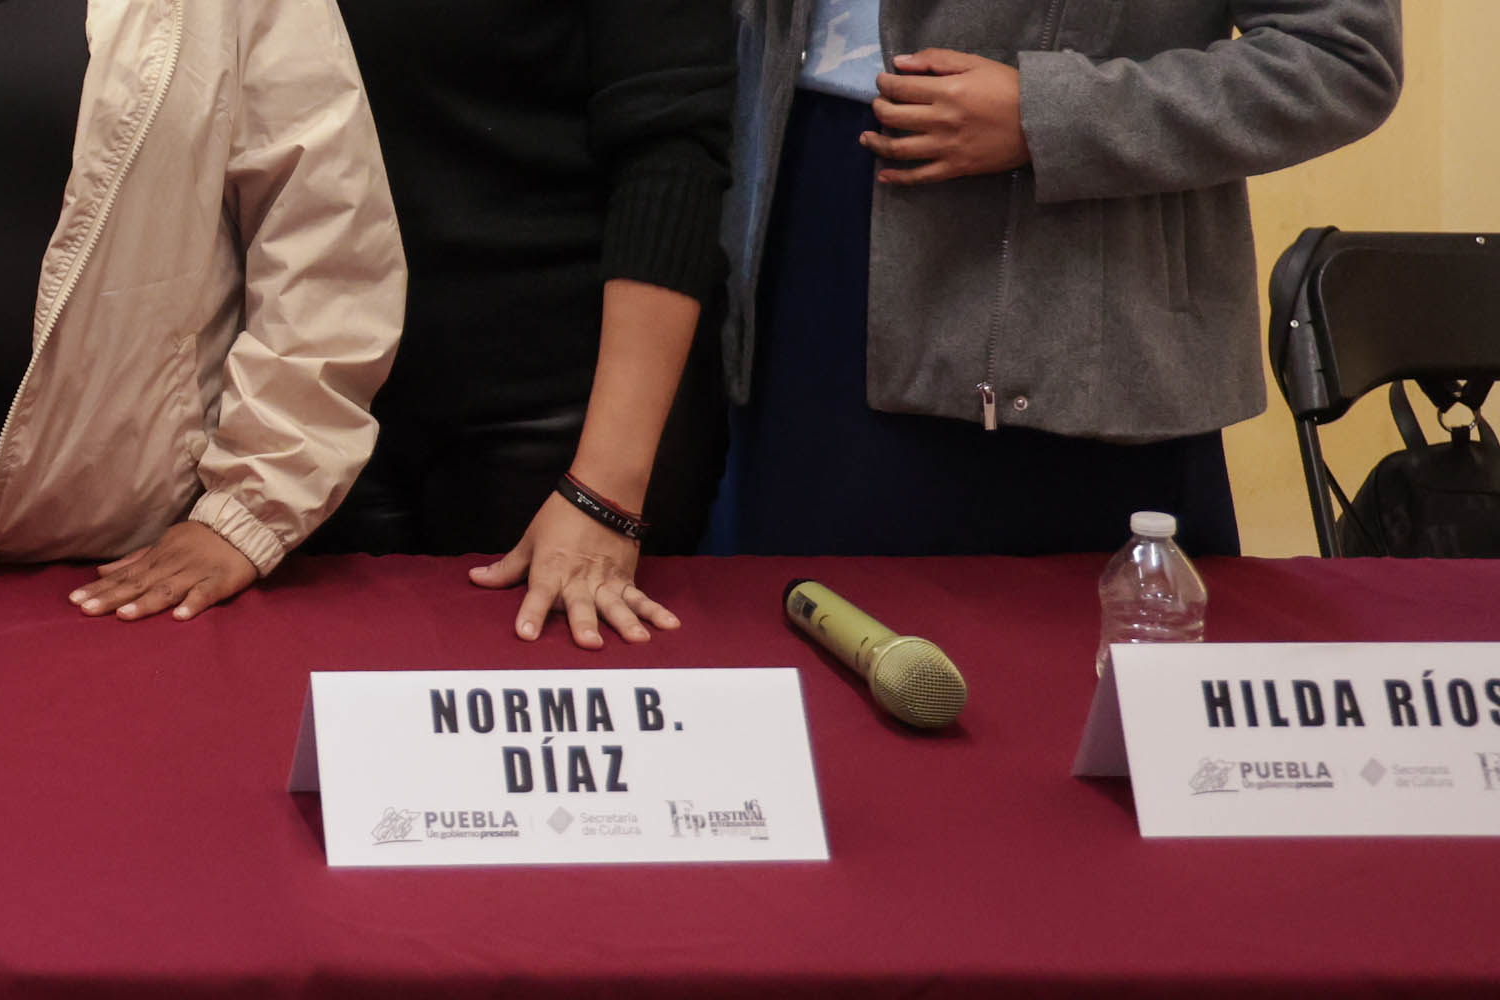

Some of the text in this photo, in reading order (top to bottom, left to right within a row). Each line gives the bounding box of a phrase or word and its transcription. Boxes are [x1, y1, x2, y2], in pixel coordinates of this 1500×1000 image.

[429, 687, 684, 734] NORMA B.
[1201, 669, 1500, 727] HILDA RÍOS
[501, 736, 629, 793] DÍAZ
[1239, 761, 1333, 779] PUEBLA
[425, 810, 518, 828] PUEBLA
